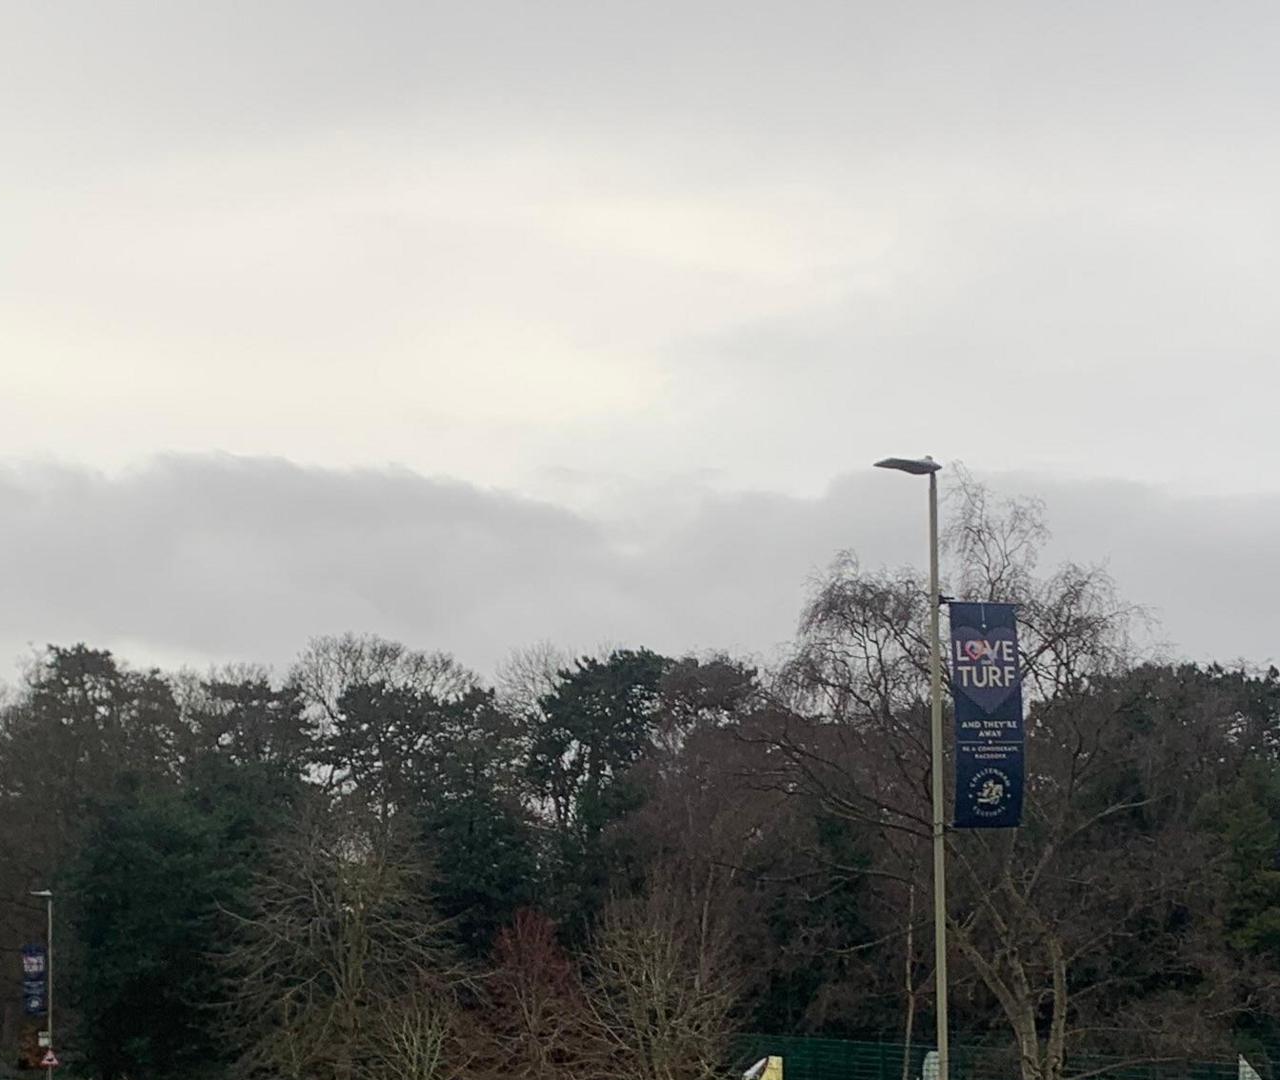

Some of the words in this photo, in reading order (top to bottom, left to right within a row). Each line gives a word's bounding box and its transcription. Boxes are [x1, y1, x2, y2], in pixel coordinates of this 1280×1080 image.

[956, 640, 1014, 661] LOVE
[958, 666, 1015, 687] TURF
[969, 768, 1010, 787] CHELTENHAM
